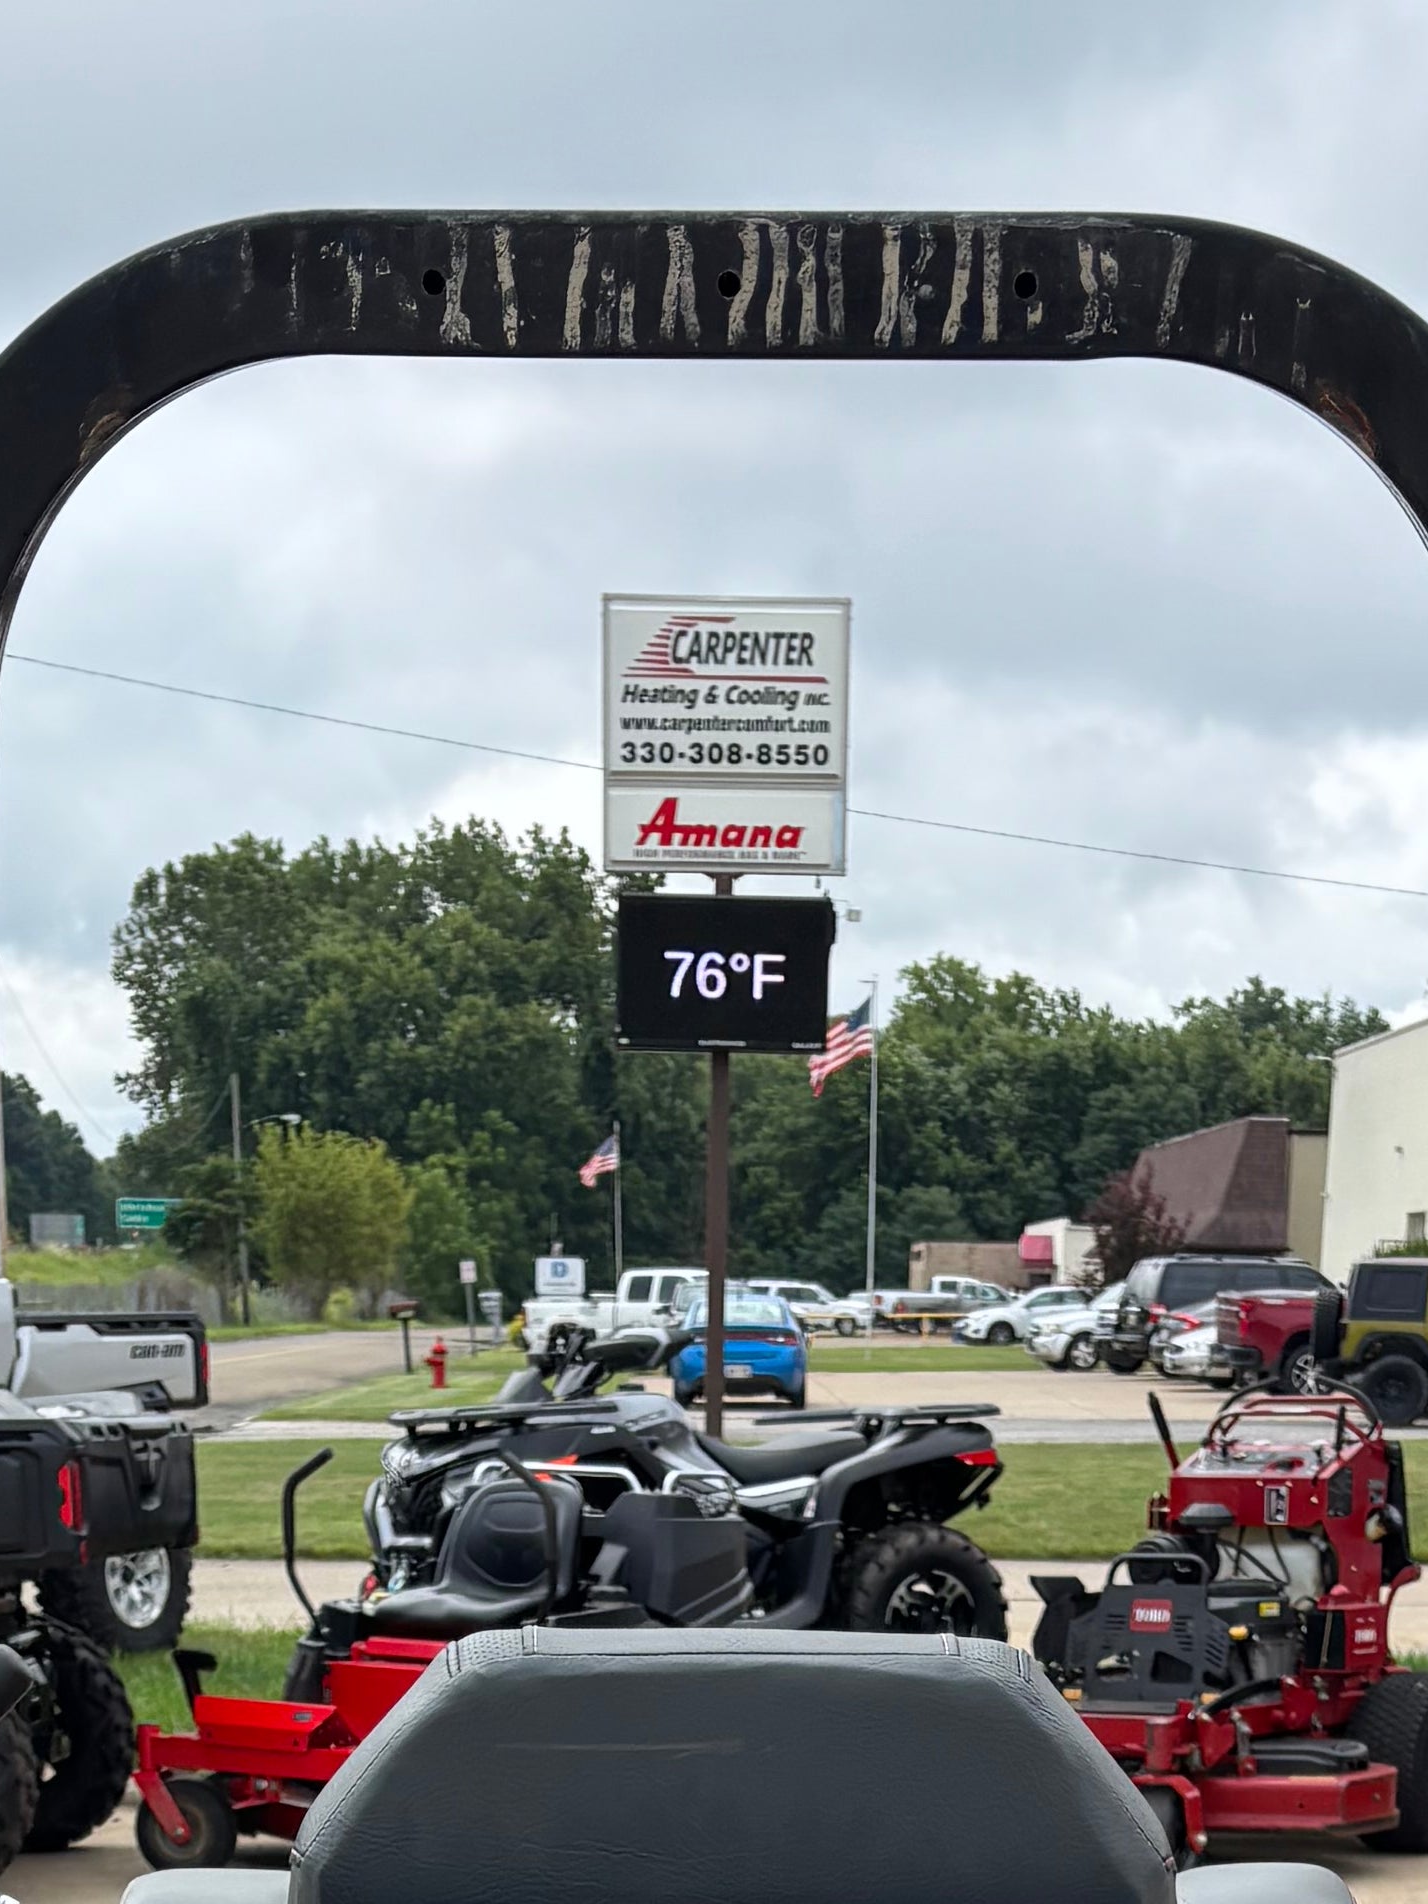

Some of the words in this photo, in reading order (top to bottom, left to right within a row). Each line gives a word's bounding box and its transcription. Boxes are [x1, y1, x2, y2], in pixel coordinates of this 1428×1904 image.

[672, 630, 815, 667] CARPENTER
[620, 684, 700, 709] Heating
[704, 685, 719, 704] &
[725, 685, 800, 711] Cooling
[634, 797, 806, 848] Amana
[663, 951, 787, 1000] 76°F
